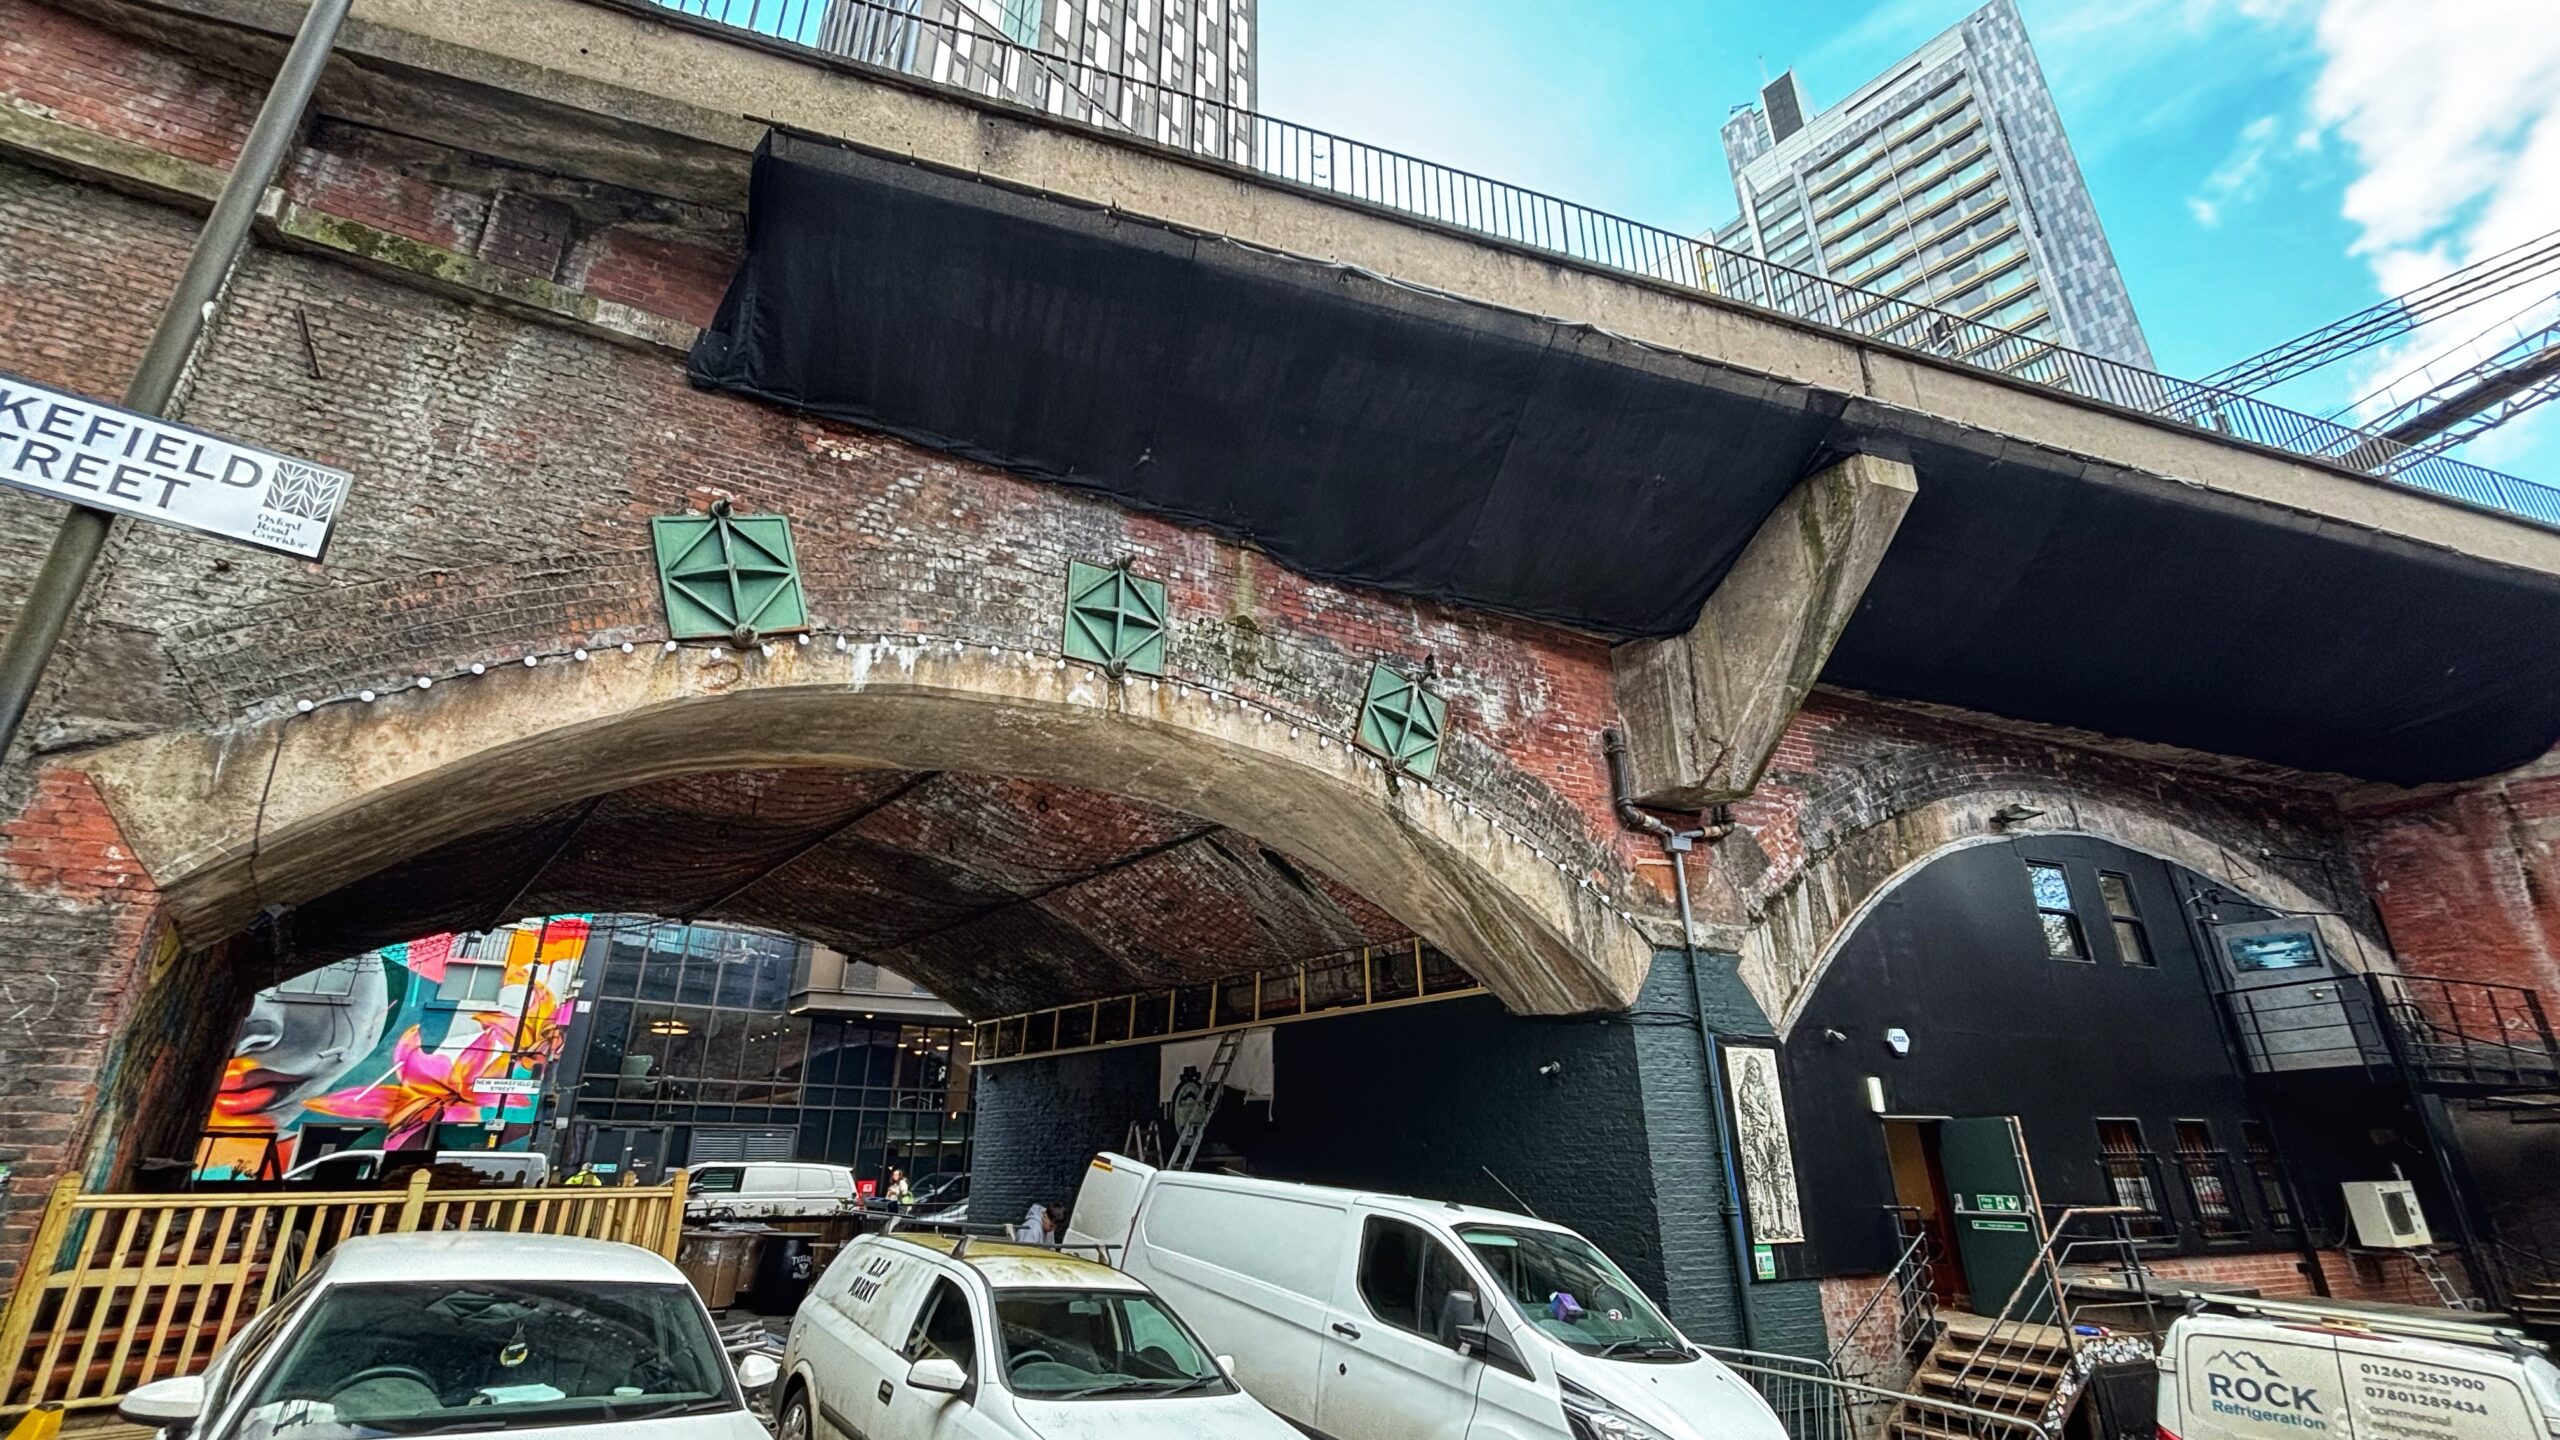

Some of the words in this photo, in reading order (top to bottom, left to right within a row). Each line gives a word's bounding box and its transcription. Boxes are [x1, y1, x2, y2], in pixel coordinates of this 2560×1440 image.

[256, 522, 290, 536] Road
[257, 513, 302, 531] Oxford
[252, 529, 308, 549] Corridor
[2361, 1363, 2413, 1380] 01260
[2416, 1371, 2485, 1391] 253900
[2208, 1372, 2323, 1415] ROCK
[2365, 1386, 2488, 1415] 07801289434
[2212, 1400, 2326, 1430] Refrigeration
